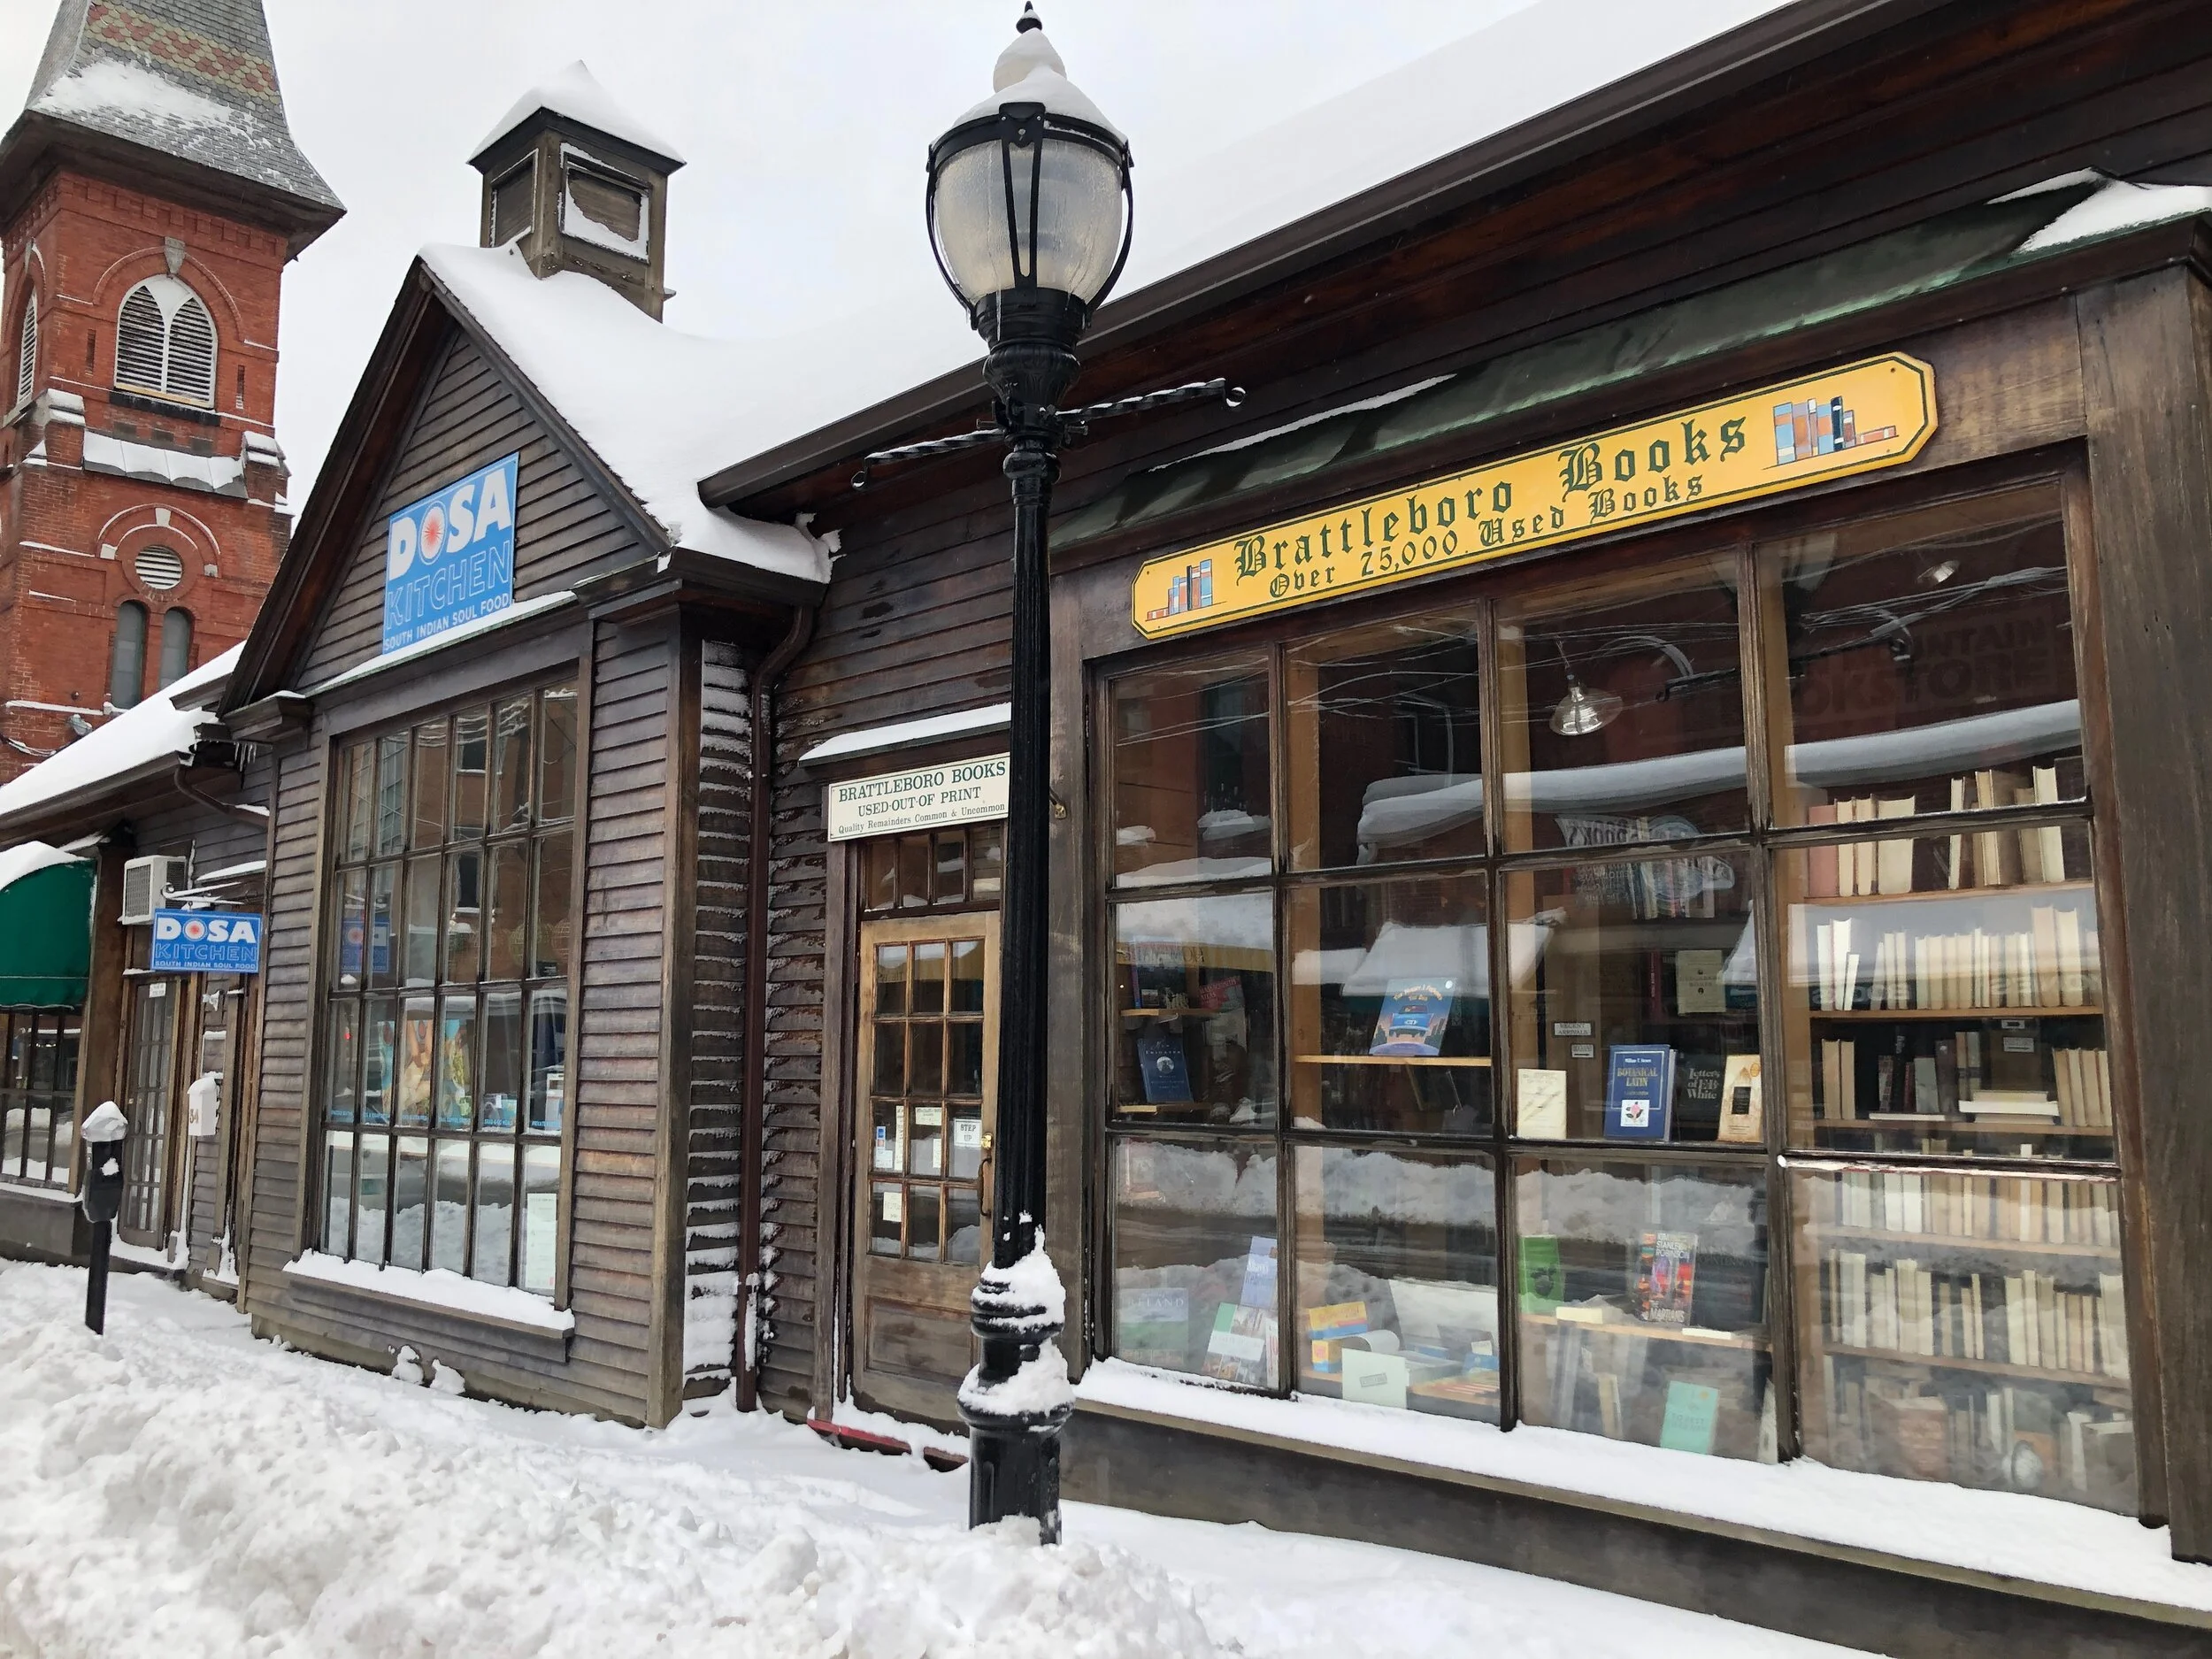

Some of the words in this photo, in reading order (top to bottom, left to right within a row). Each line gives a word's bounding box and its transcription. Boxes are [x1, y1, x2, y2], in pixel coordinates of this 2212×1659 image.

[1234, 481, 1512, 586] Brattleboro
[1558, 416, 1747, 503] Books
[389, 468, 512, 580] DOSA
[1269, 565, 1335, 598] Over
[1360, 531, 1458, 577] 75,000
[1478, 505, 1565, 548] Used
[1588, 474, 1703, 525] Books
[387, 540, 511, 630] KITCHEN
[385, 632, 412, 651] SOUTH
[417, 616, 449, 641] INDIAN
[452, 607, 478, 626] SOUL
[480, 593, 511, 612] FOOD
[839, 772, 945, 803] BRATTLEBORO
[951, 761, 1006, 784] BOOKS
[941, 787, 982, 804] PRINT
[838, 822, 864, 834] Quality
[868, 817, 911, 829] Remainders
[915, 810, 948, 823] Common
[961, 803, 1005, 816] Uncommon
[157, 918, 256, 943] DOSA
[156, 943, 257, 962] KITCHEN
[1625, 1077, 1648, 1087] LATIN
[1687, 1088, 1717, 1100] White
